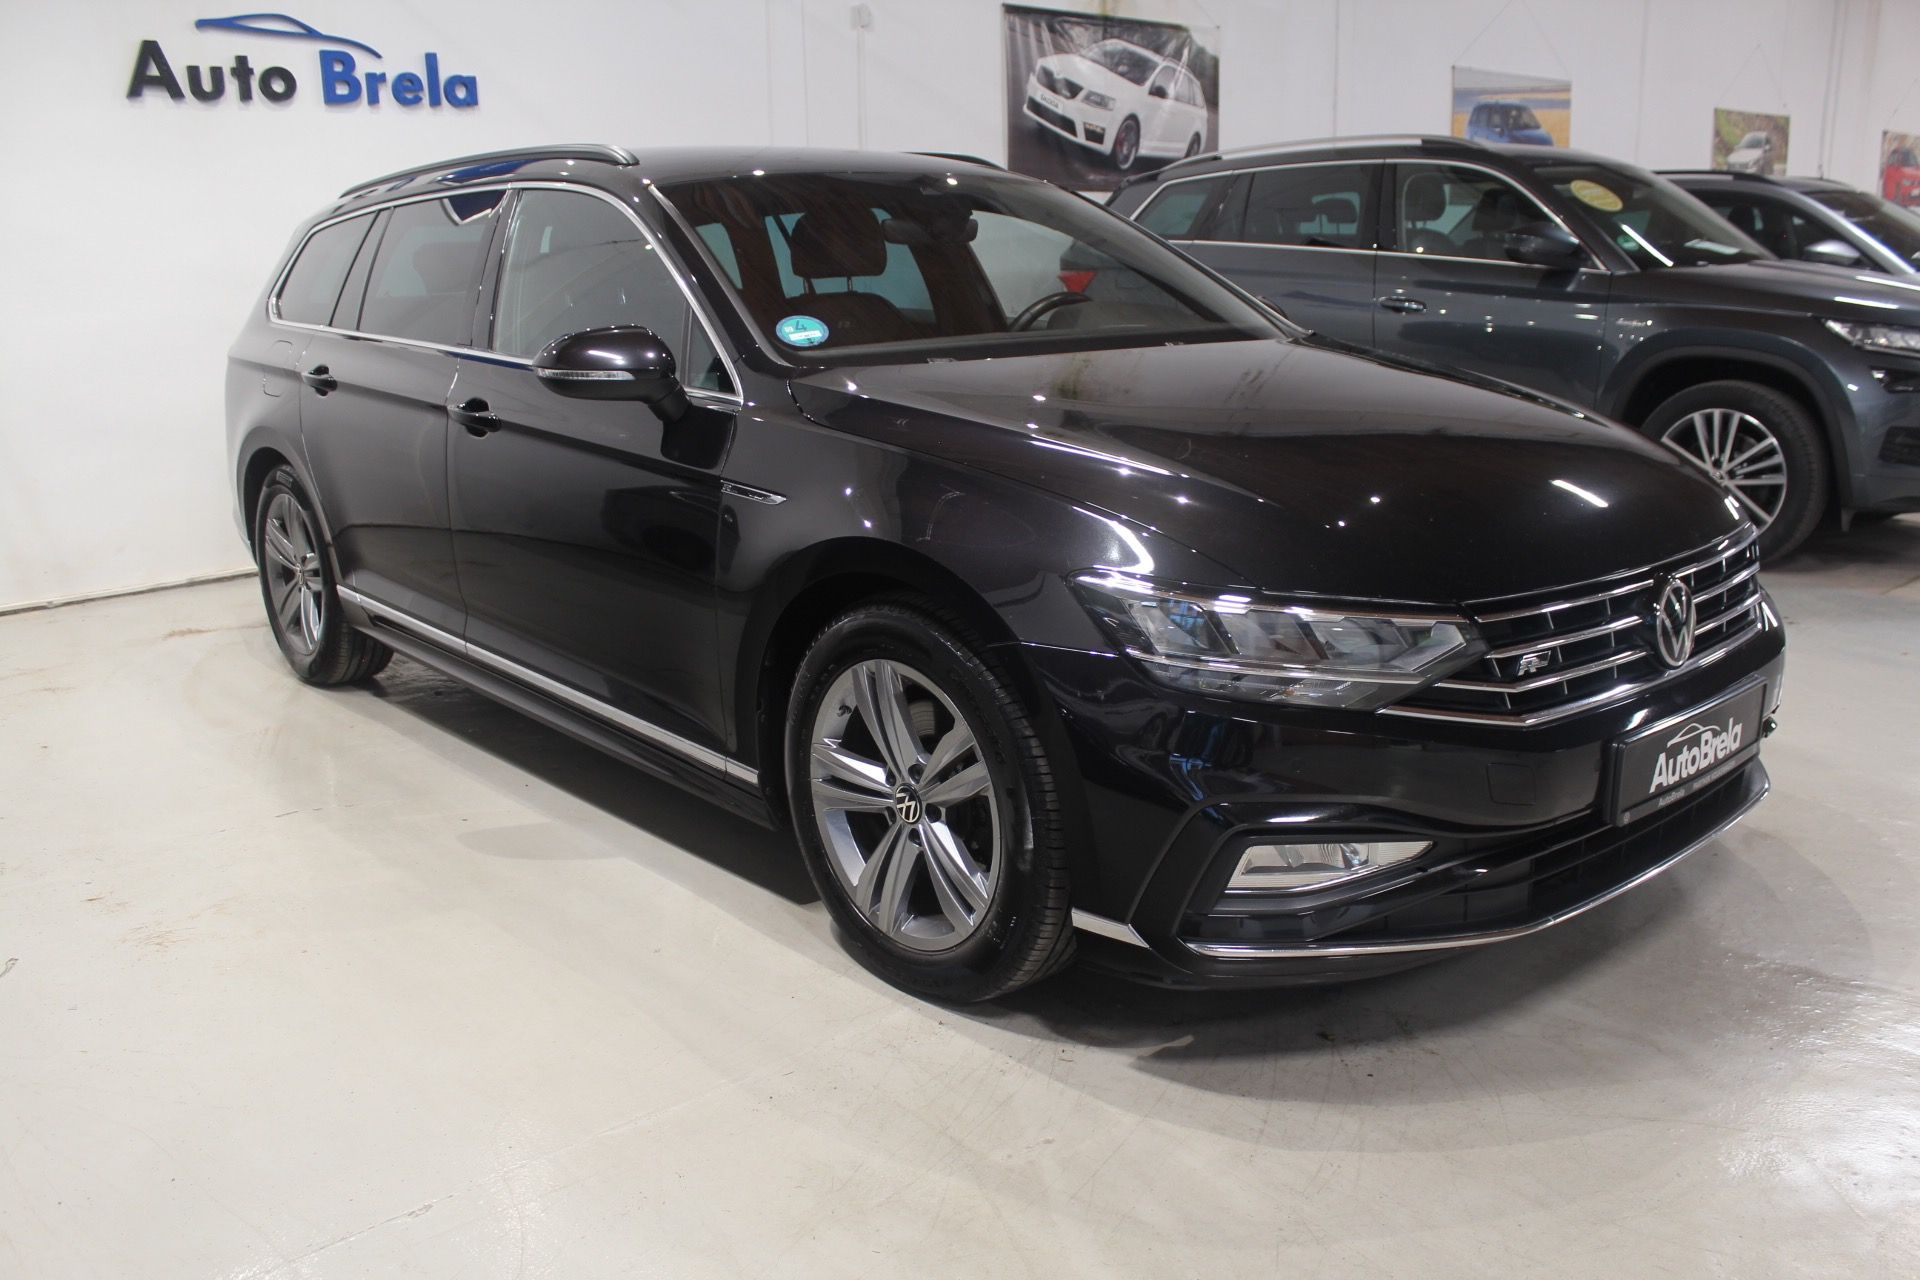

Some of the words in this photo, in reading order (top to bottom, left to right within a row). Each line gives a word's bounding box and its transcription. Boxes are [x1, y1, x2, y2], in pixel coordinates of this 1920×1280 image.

[126, 39, 298, 102] Auto
[318, 49, 479, 108] Brela
[795, 320, 807, 331] 4
[1648, 717, 1743, 794] AutoBrela
